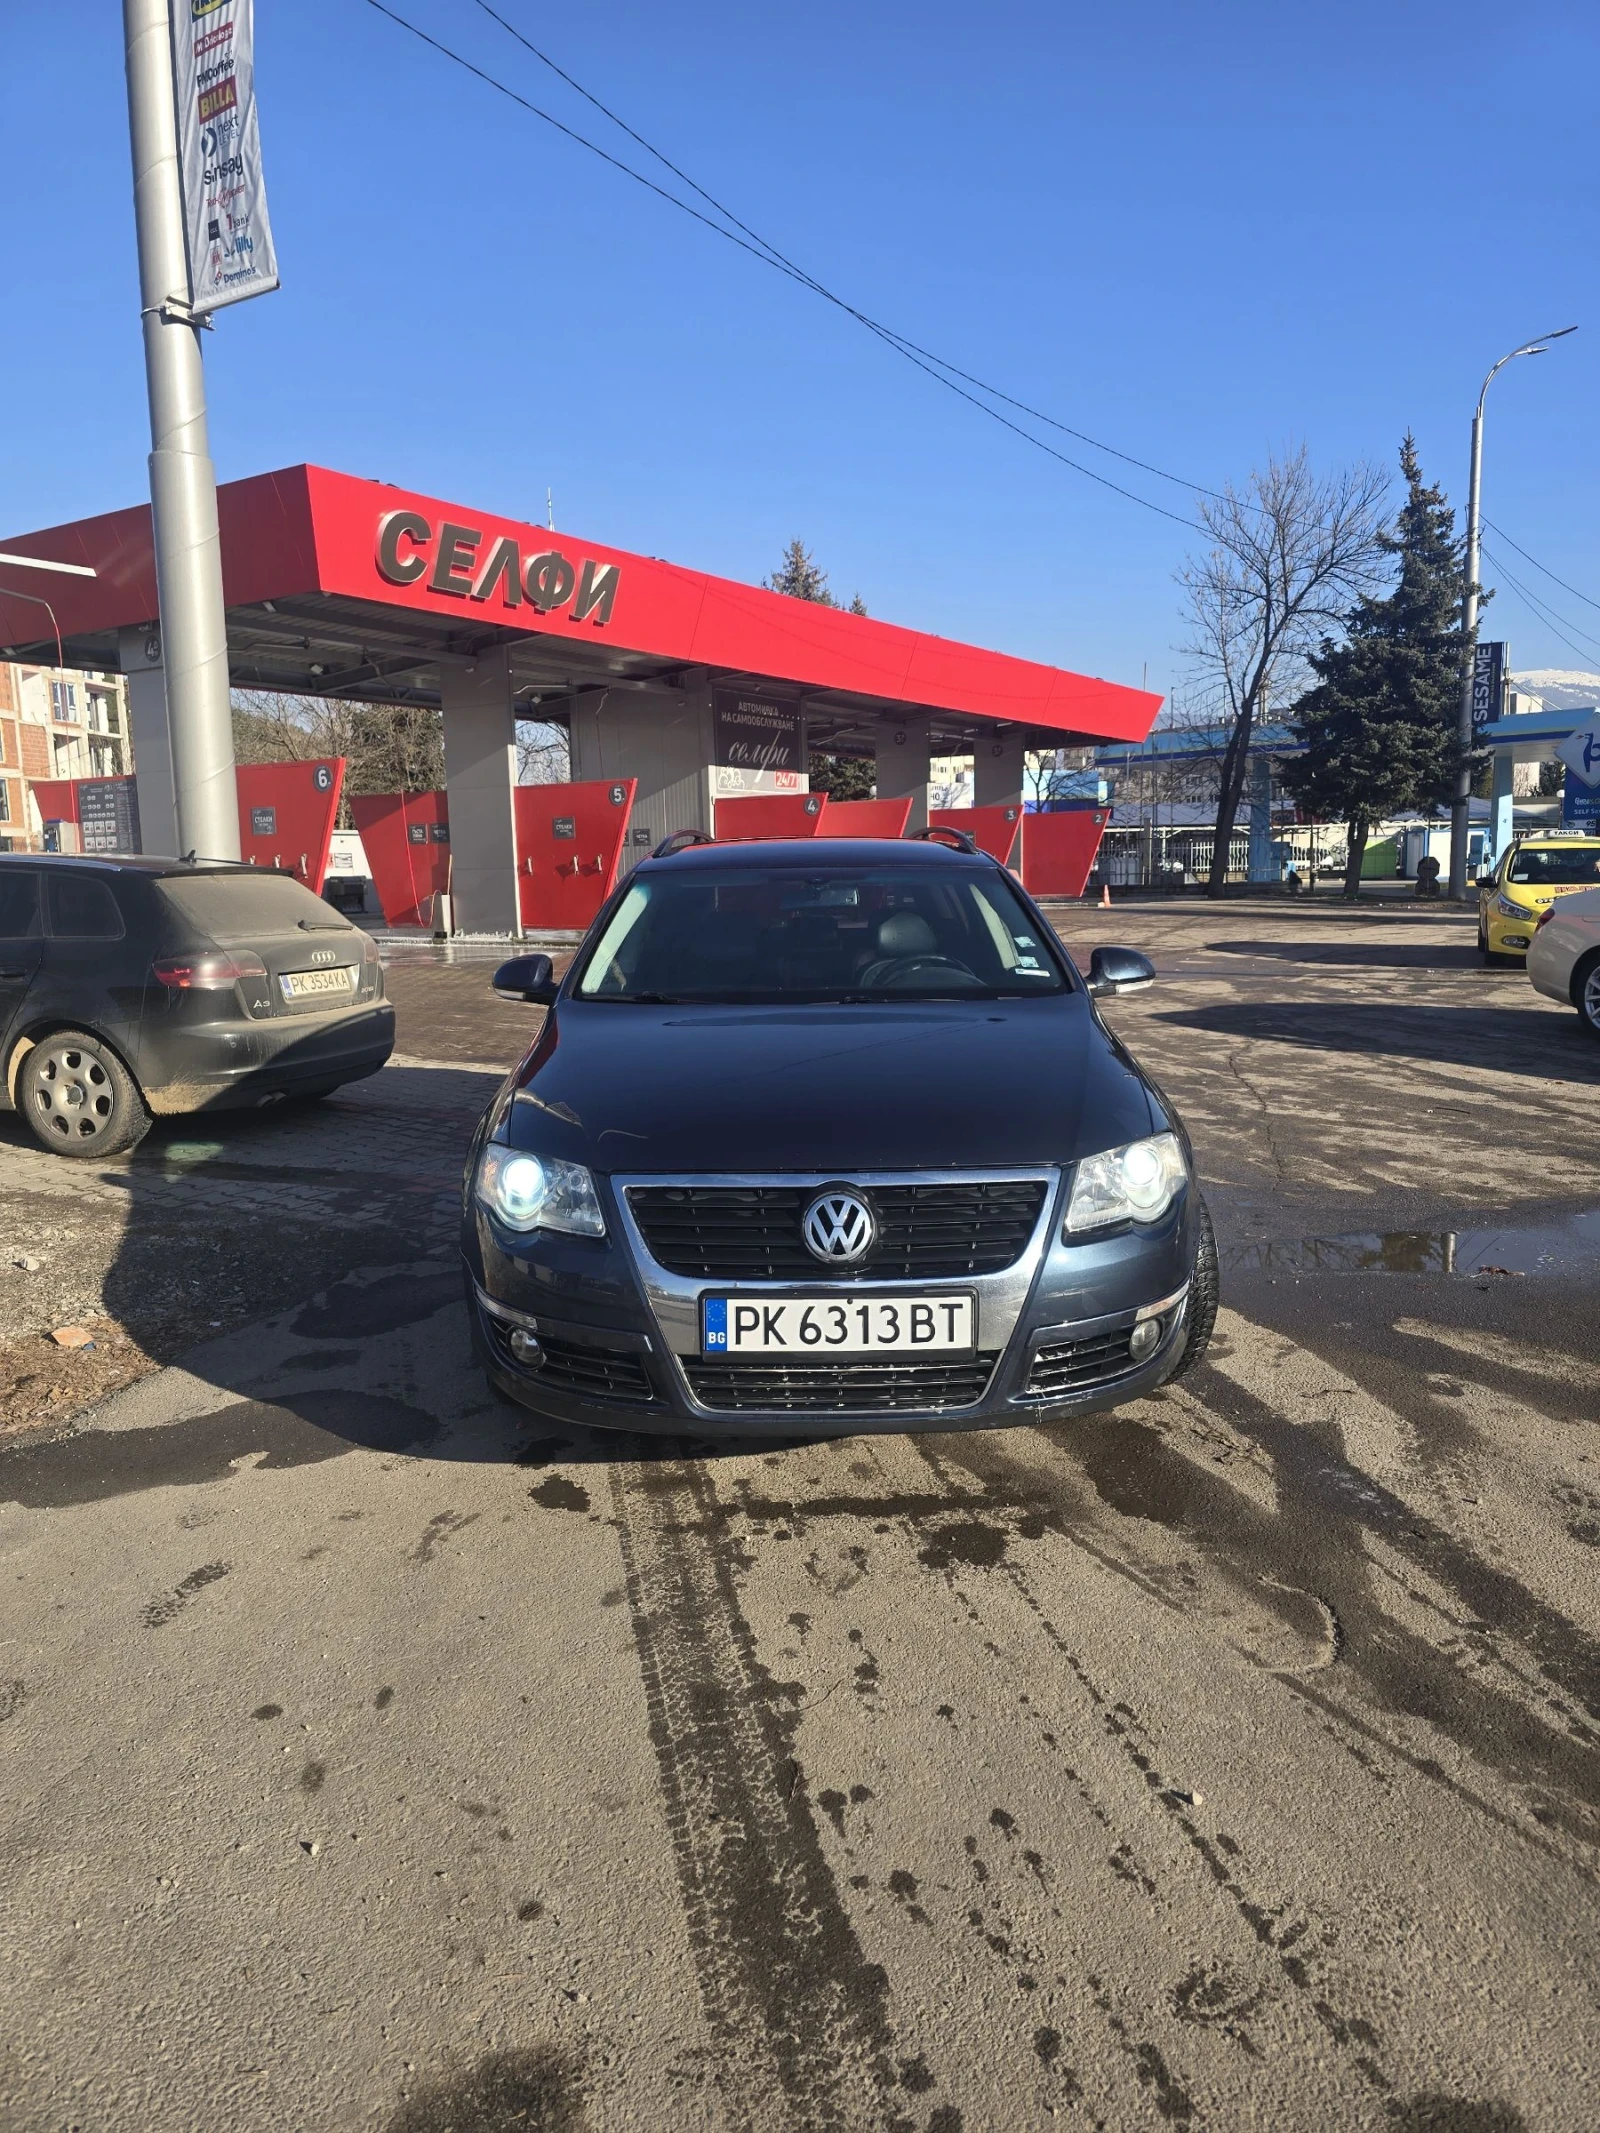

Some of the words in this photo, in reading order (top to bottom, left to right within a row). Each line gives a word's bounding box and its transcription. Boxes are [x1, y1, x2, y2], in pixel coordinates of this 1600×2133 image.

[201, 84, 235, 118] BILLA
[218, 114, 239, 134] next
[203, 153, 243, 185] sinsay
[235, 235, 253, 253] lilly
[223, 265, 256, 283] Domino's
[375, 509, 622, 627] СЕЛФИ
[1473, 646, 1492, 721] SESAME
[738, 701, 779, 717] АВТОМИВКА
[721, 711, 732, 722] НА
[732, 713, 795, 731] САМООБСЛУЖВАНЕ
[728, 730, 789, 783] селфи
[776, 771, 796, 787] 24/7
[1585, 820, 1596, 828] 95
[291, 975, 307, 993] PK
[310, 971, 333, 990] 3534
[253, 1000, 270, 1009] A3
[735, 1305, 787, 1345] PK
[800, 1304, 900, 1345] 6313
[911, 1303, 964, 1344] BT
[708, 1331, 726, 1344] BG
